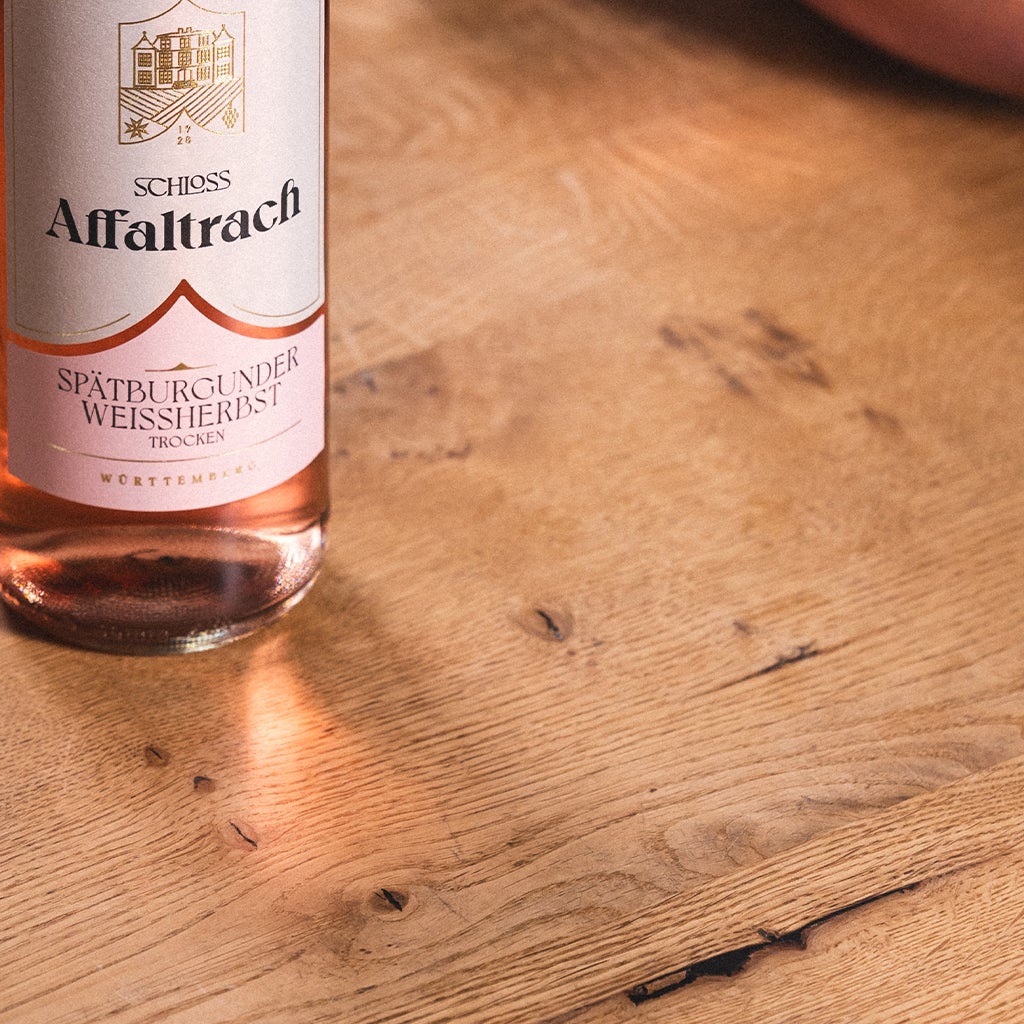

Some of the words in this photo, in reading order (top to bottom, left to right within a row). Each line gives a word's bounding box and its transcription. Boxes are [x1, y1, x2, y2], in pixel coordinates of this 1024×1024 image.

[133, 169, 232, 198] SCHLOSS
[45, 178, 302, 252] Affaltrach
[57, 345, 300, 404] SPÄTBURGUNDER
[82, 382, 282, 431] WEISSHERBST
[149, 429, 226, 450] TROCKEN
